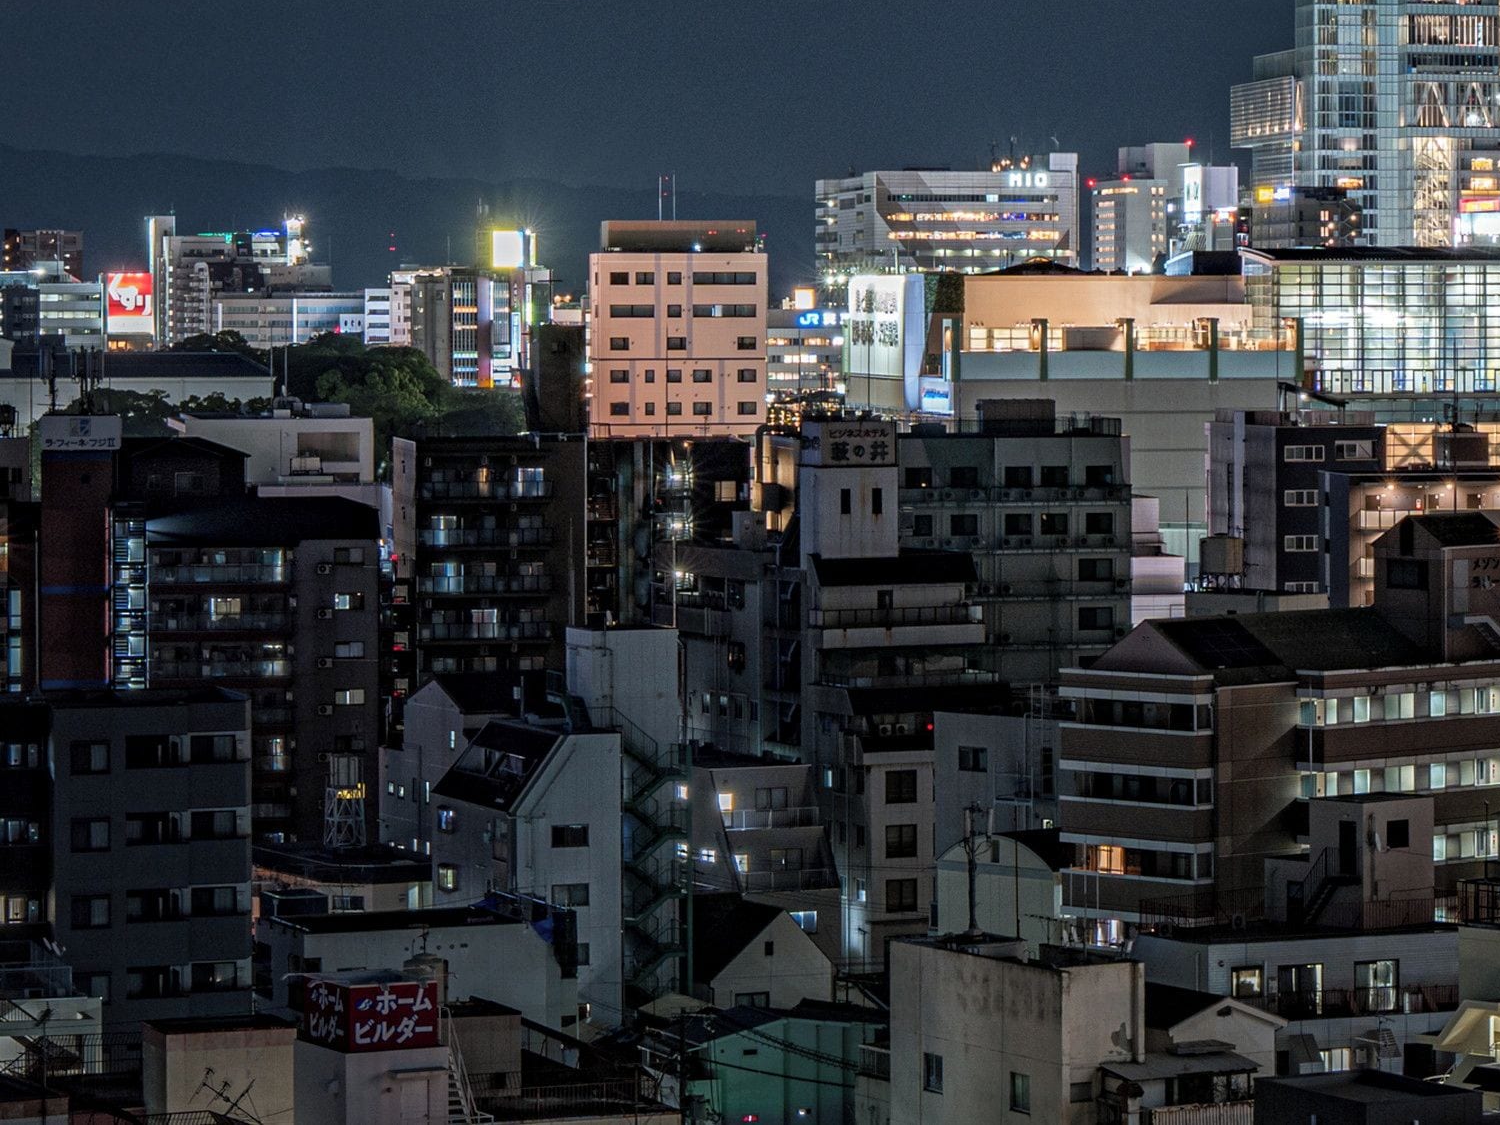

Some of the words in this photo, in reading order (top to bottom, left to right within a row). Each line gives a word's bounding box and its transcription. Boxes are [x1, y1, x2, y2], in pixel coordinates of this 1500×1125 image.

[1009, 172, 1048, 188] MIO
[799, 312, 820, 325] JR
[375, 988, 433, 1015] ホーム
[355, 1014, 433, 1045] ビルダー
